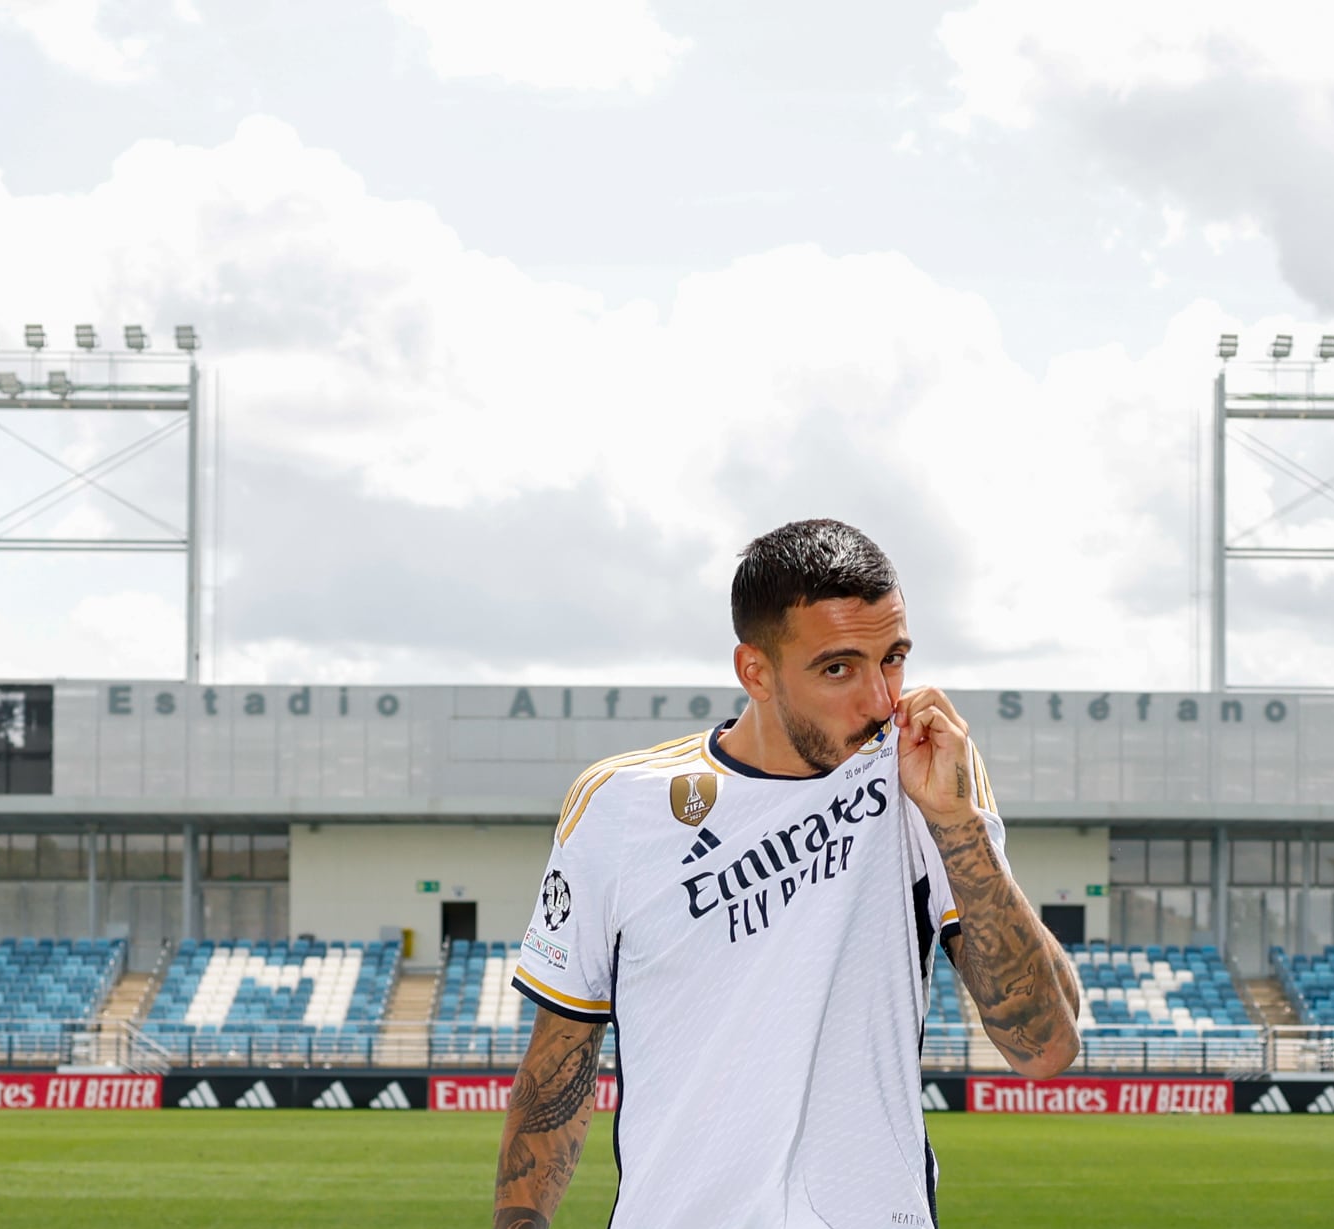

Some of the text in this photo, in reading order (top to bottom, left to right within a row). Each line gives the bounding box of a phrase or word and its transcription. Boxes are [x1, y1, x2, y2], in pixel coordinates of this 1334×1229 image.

[108, 685, 1287, 722] Estadio Alfre Stéfano
[684, 800, 706, 815] FIFA
[681, 778, 888, 919] Emirates
[728, 889, 769, 943] FLY
[46, 1078, 81, 1109] FLY
[83, 1078, 157, 1109] BETTER
[435, 1080, 512, 1111] Emir
[973, 1081, 1227, 1113] Emirates FLY BETTER
